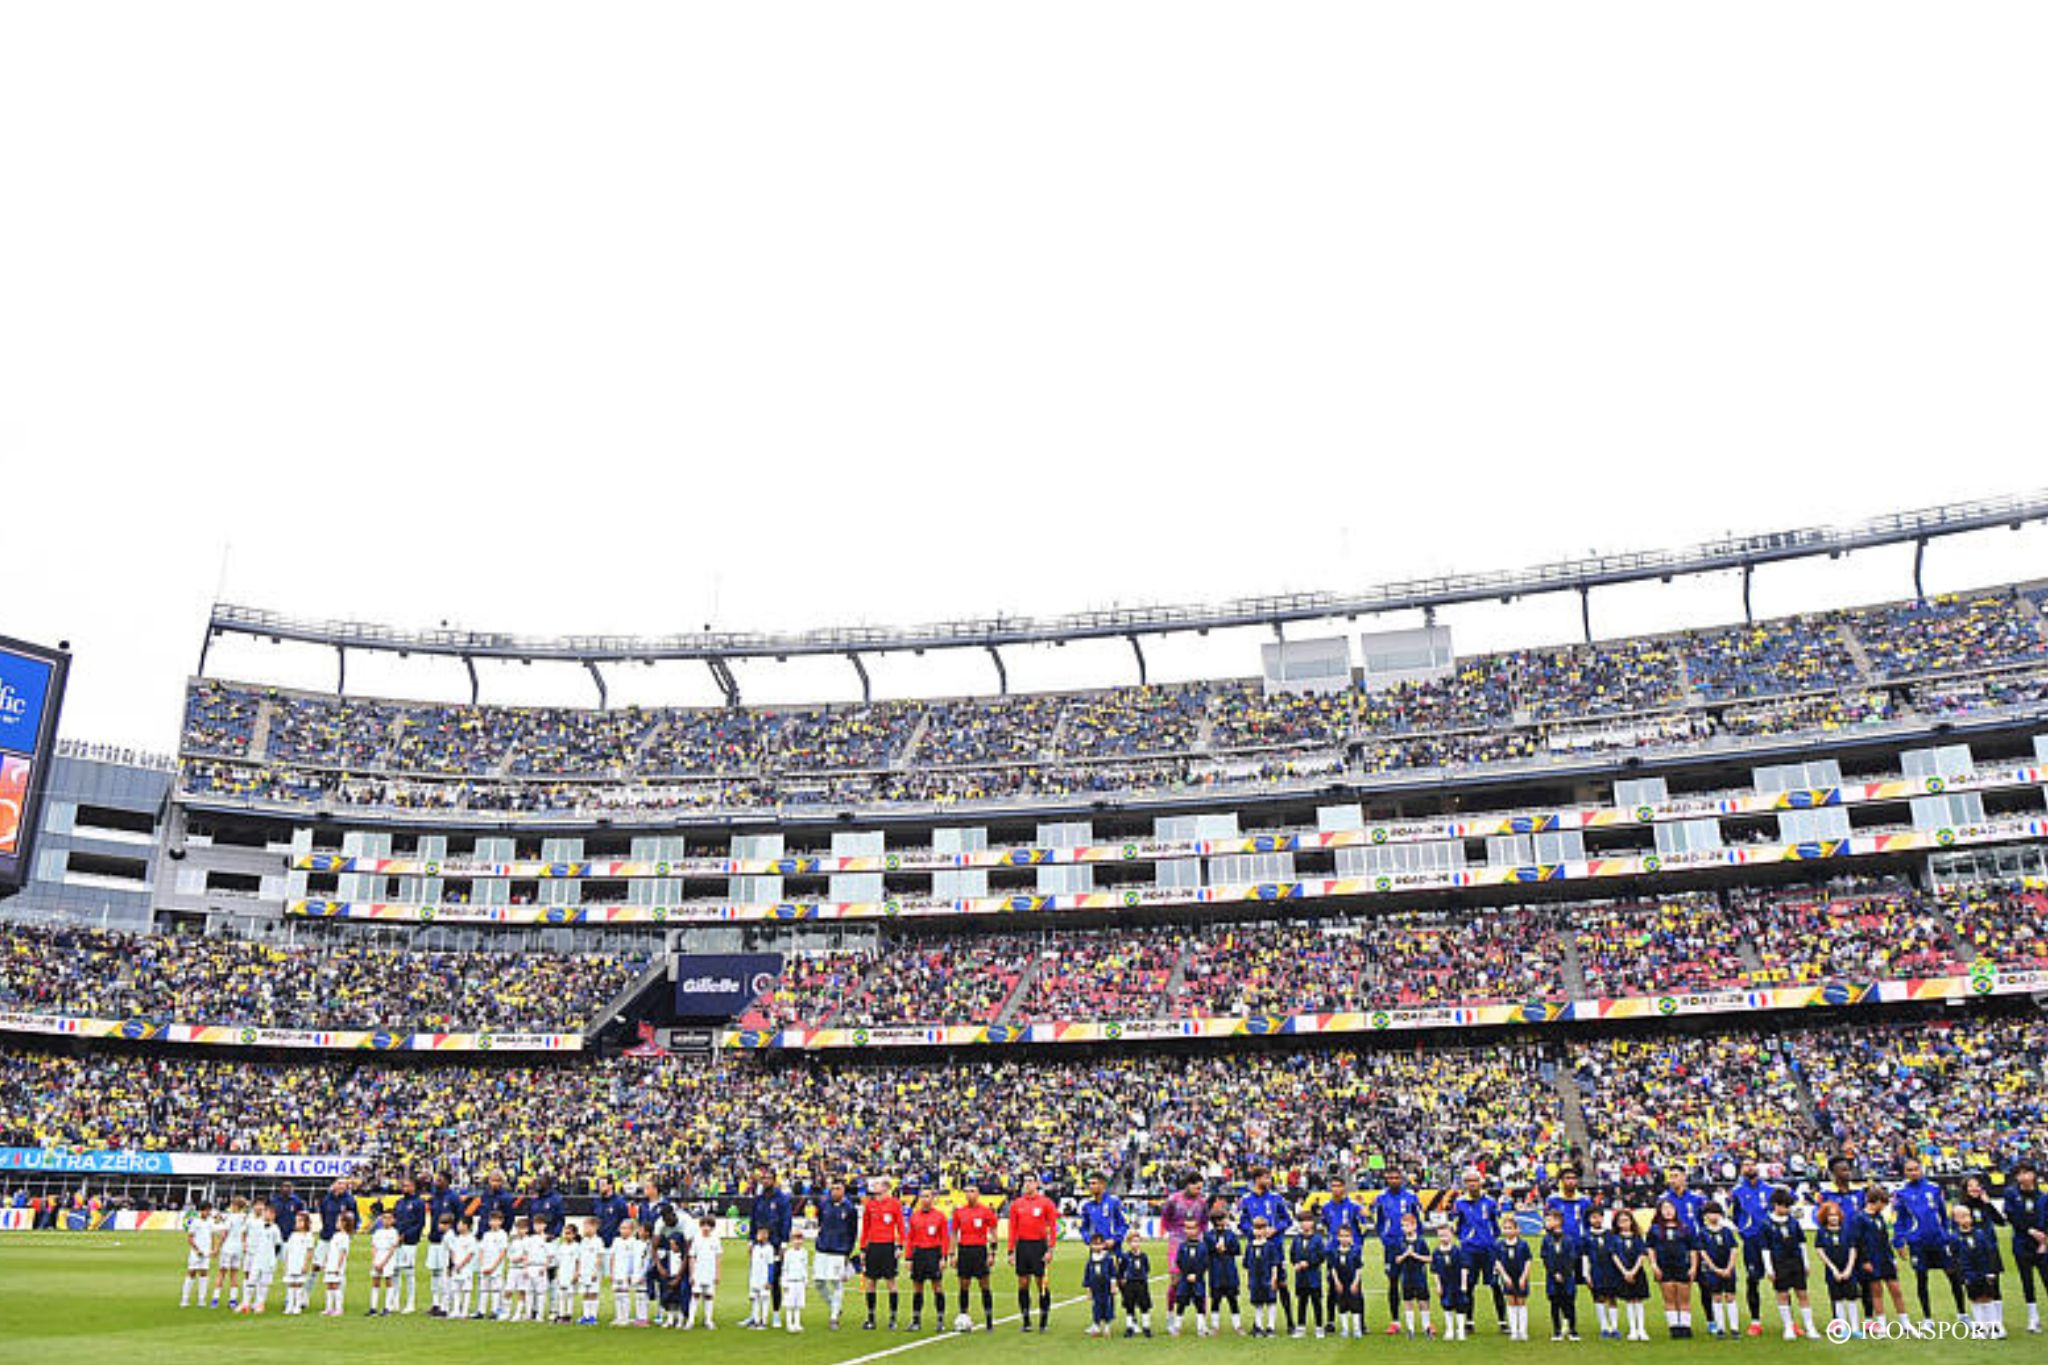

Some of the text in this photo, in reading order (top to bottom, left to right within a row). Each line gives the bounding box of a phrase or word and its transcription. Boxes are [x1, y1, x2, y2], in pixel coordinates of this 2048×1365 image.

[24, 1151, 96, 1170] ULTRA
[101, 1154, 161, 1172] ZERO
[216, 1158, 358, 1176] ZERO ALCOHO
